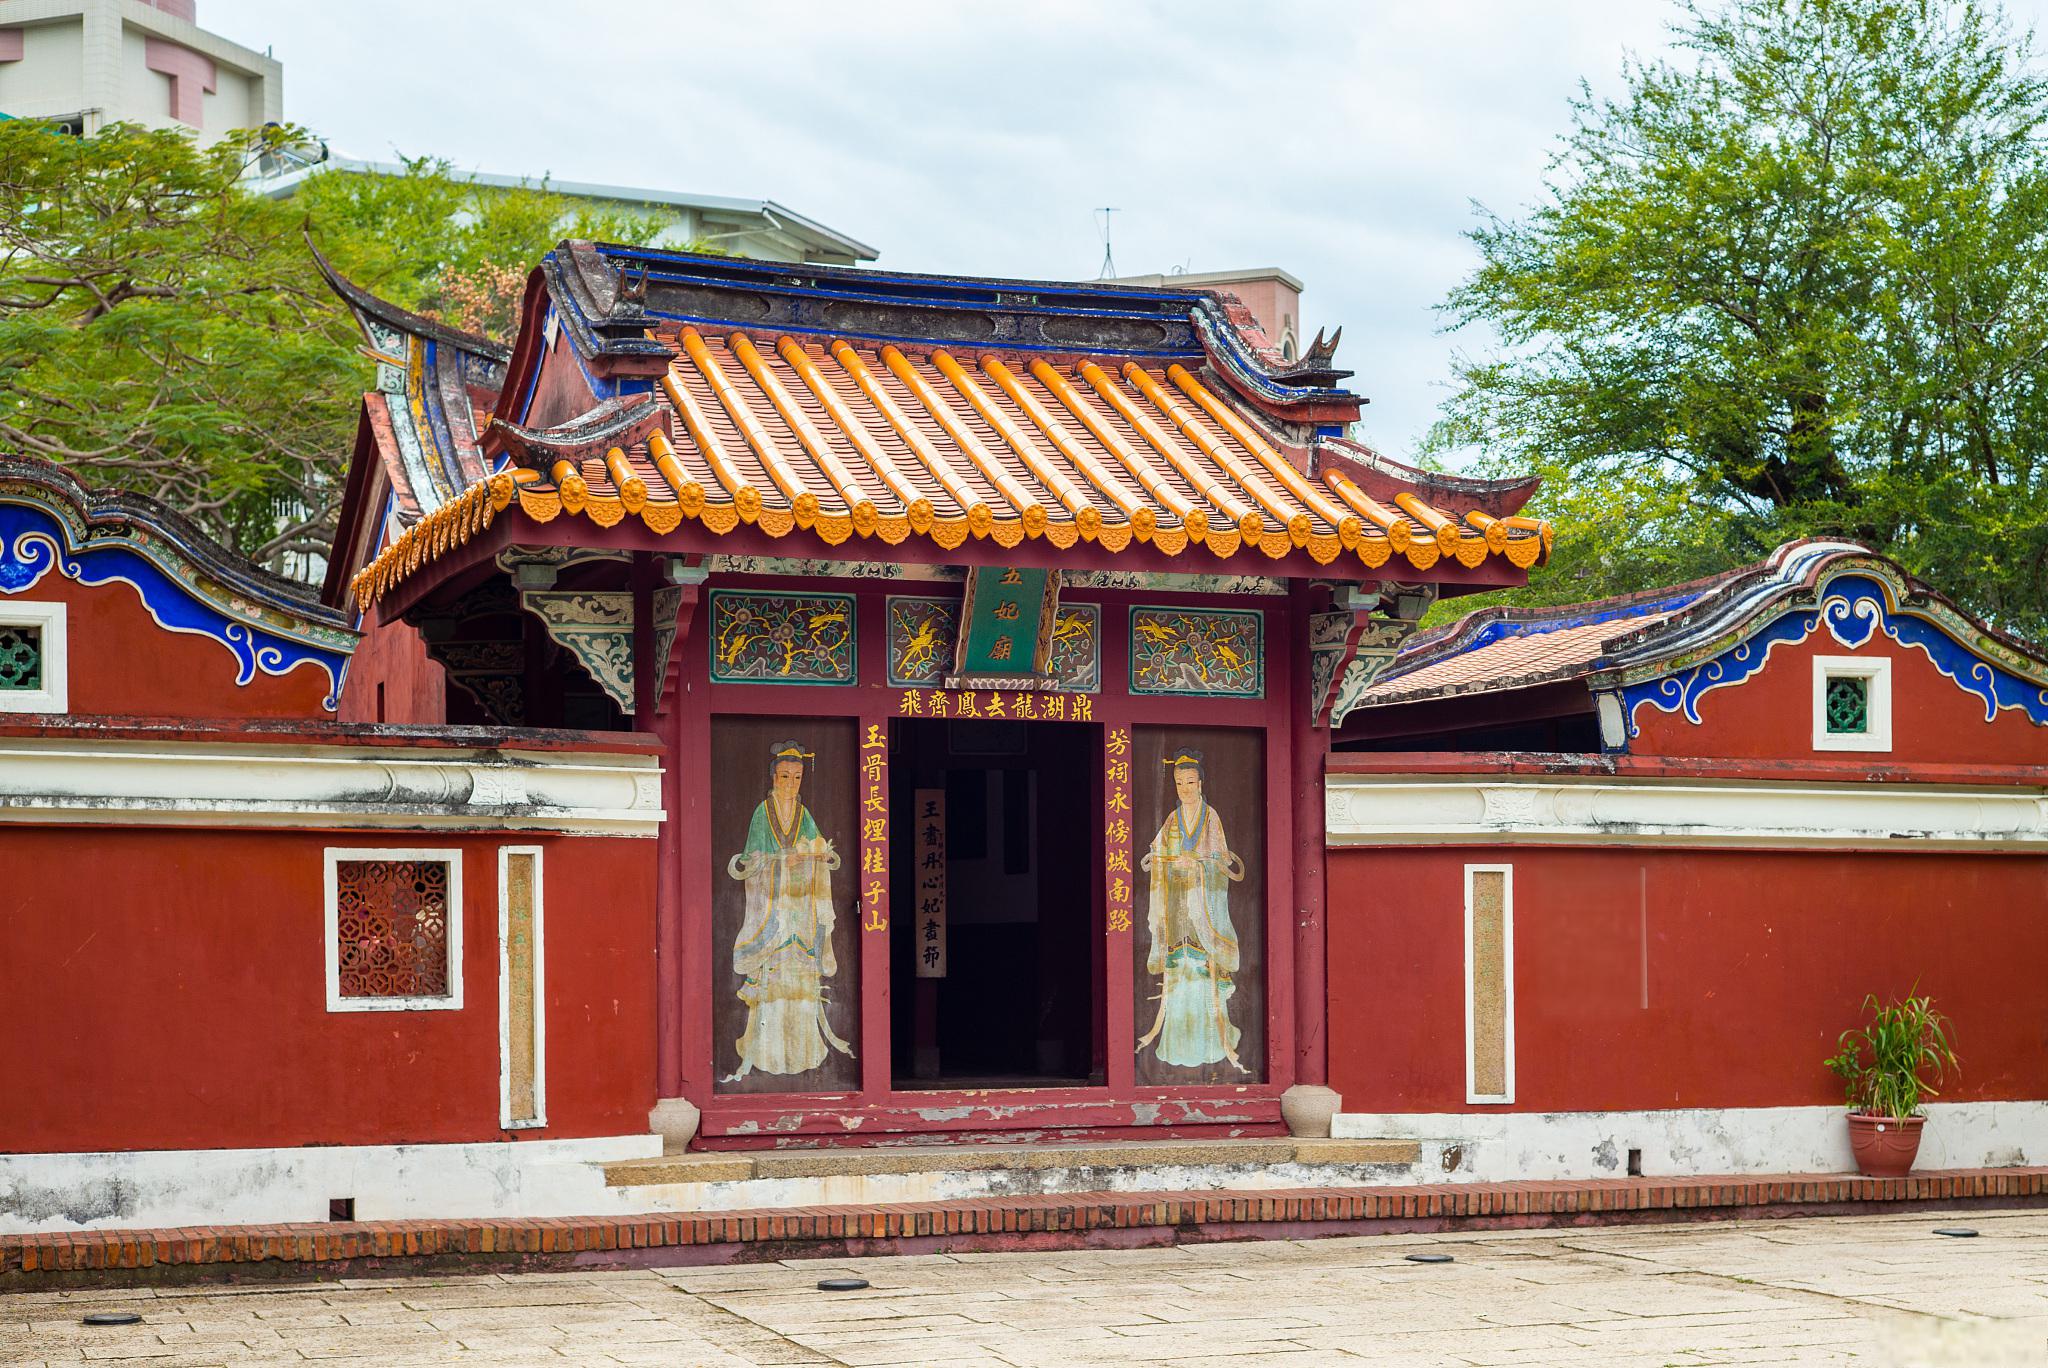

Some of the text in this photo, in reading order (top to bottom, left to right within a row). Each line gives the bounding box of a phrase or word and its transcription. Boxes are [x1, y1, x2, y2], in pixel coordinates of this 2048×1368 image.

[986, 567, 1023, 660] 五妃廟
[862, 724, 888, 932] 玉骨長埋桂子山
[1105, 728, 1132, 932] 芳祠永傍城南路
